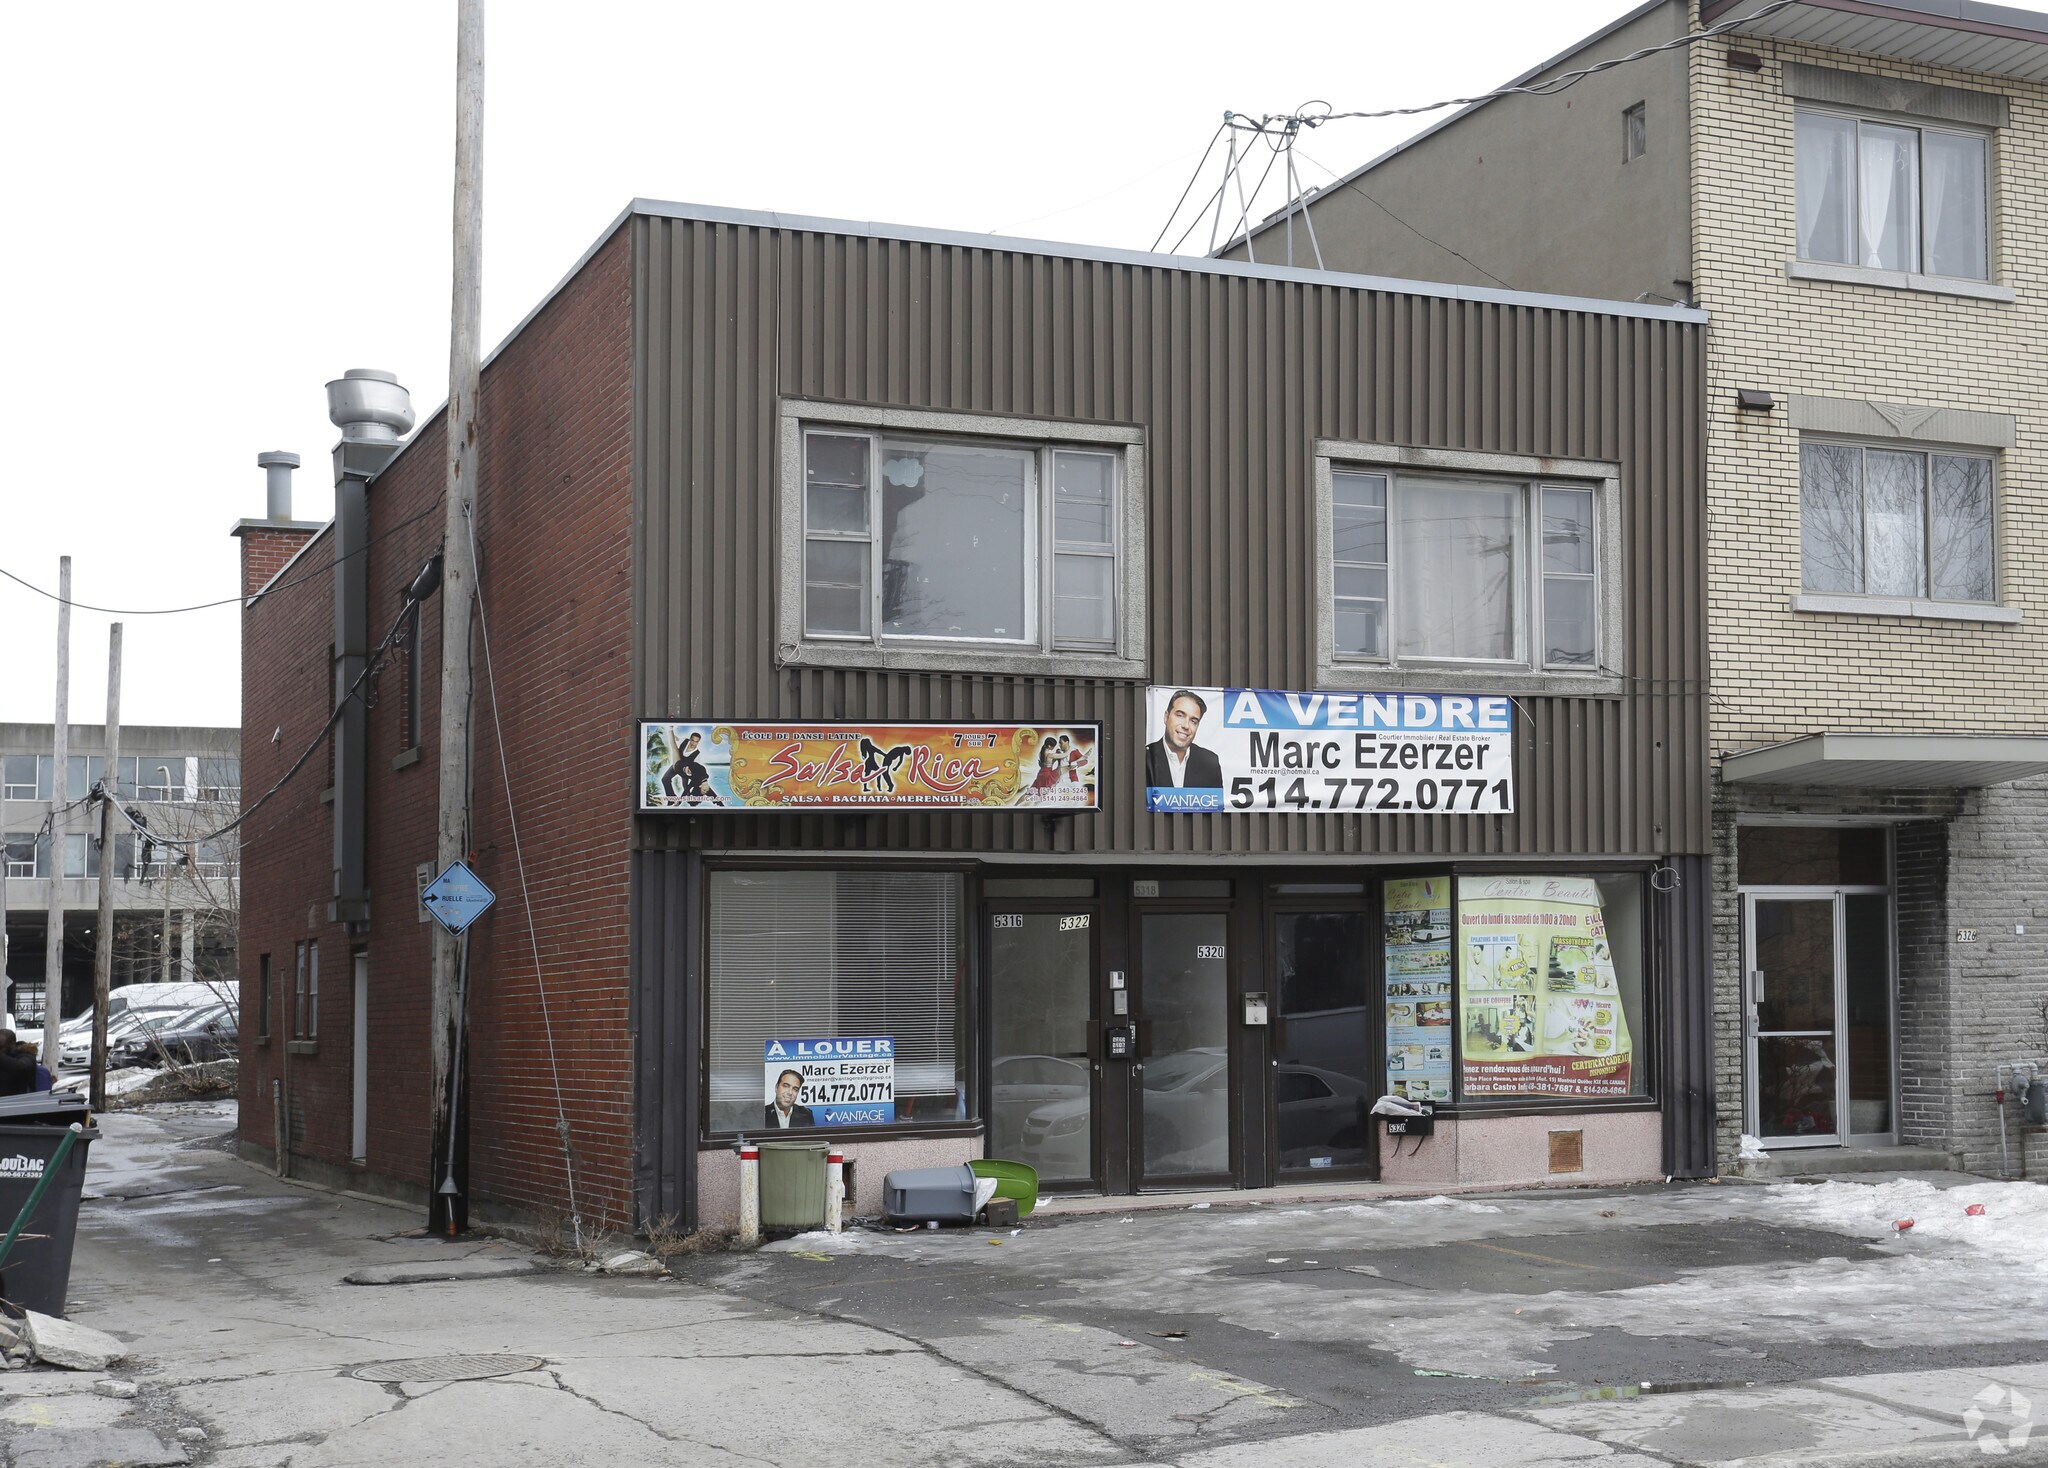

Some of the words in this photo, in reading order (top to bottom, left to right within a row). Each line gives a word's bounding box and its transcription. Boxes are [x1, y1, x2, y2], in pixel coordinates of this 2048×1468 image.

[1285, 693, 1508, 728] VENDRE
[742, 731, 772, 740] ÉCOLE
[776, 732, 789, 740] DE
[793, 732, 824, 740] DANSE
[828, 732, 861, 740] LATINE
[954, 733, 963, 748] 7
[987, 733, 997, 748] 7
[1378, 733, 1402, 741] Courtier
[1452, 734, 1470, 742] Estate
[1249, 731, 1341, 769] Marc
[1355, 733, 1490, 770] Ezerzer
[760, 742, 888, 789] Salsa
[908, 744, 1000, 793] Rica
[1250, 768, 1320, 776] mezerzer@hotmail.ca
[782, 795, 823, 803] SALSA
[832, 795, 891, 803] BACHATA
[896, 795, 967, 803] MERENGUE
[1163, 794, 1219, 807] VANTAGE
[1230, 777, 1510, 811] 514.772.0771
[1135, 885, 1156, 896] 5318
[994, 915, 1022, 927] 5316
[1060, 915, 1089, 930] 5322
[1462, 913, 1480, 926] Ouvert
[1481, 913, 1487, 925] du
[1511, 913, 1532, 925] samedi
[1958, 930, 1976, 941] 5326
[1198, 946, 1224, 958] 5320
[767, 1040, 787, 1056] À
[798, 1040, 892, 1055] LOUER
[802, 1064, 835, 1076] Marc
[840, 1063, 891, 1075] Ezerzer
[1481, 1064, 1520, 1073] rendez-vous
[801, 1083, 892, 1104] 514.772.0771
[1492, 1083, 1516, 1091] Castro
[1575, 1085, 1581, 1093] &
[833, 1109, 885, 1121] VANTAGE
